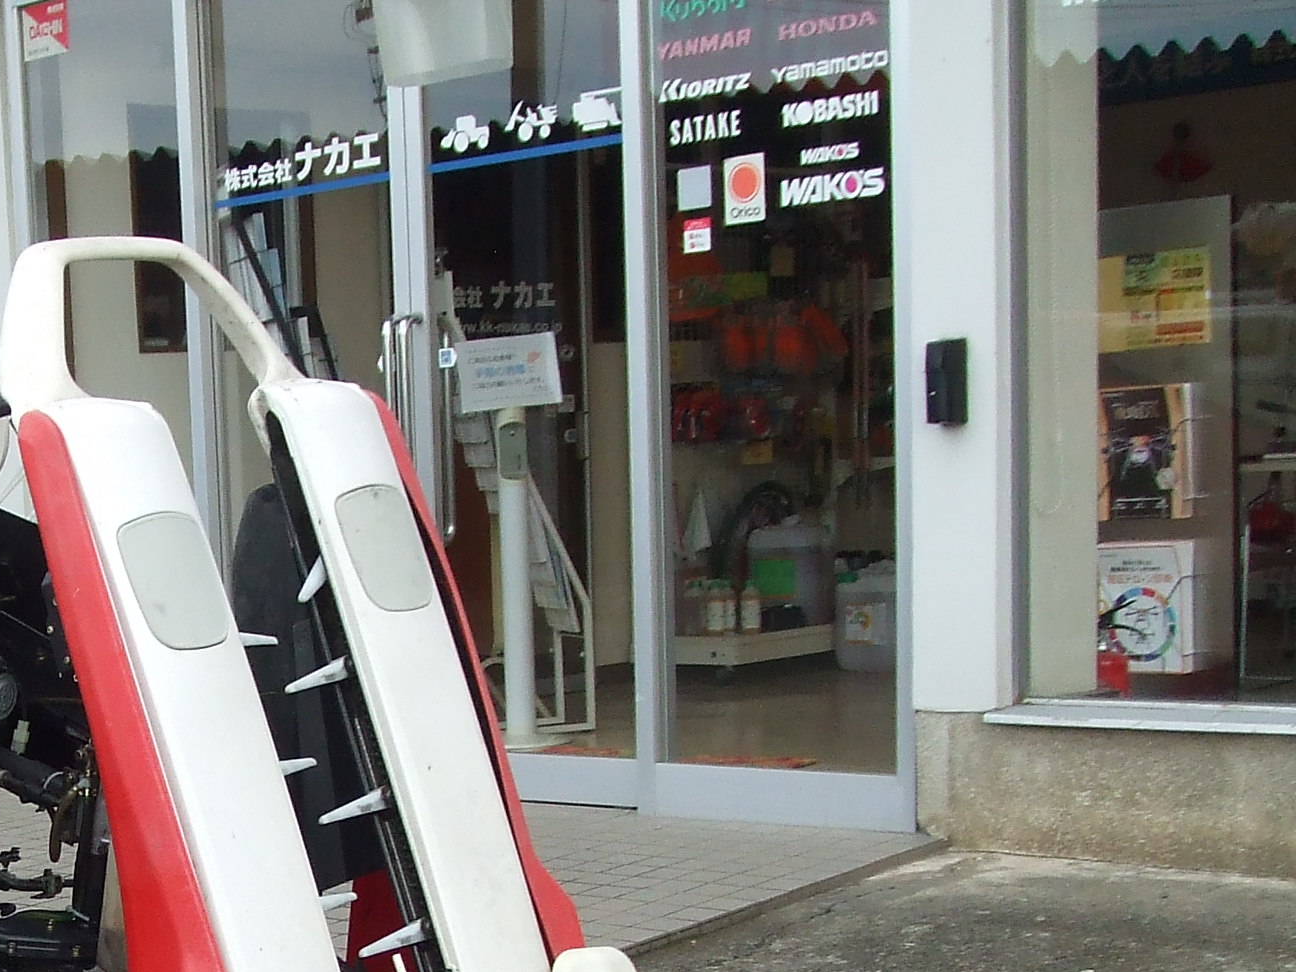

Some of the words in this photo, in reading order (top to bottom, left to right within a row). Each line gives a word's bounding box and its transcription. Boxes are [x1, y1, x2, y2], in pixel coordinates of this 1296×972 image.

[778, 10, 878, 41] HONDA
[658, 28, 752, 61] YANMAR
[659, 72, 752, 104] KIORITZ
[781, 90, 879, 129] KOBASHI
[669, 109, 741, 147] SATAKE
[730, 206, 761, 219] Orico
